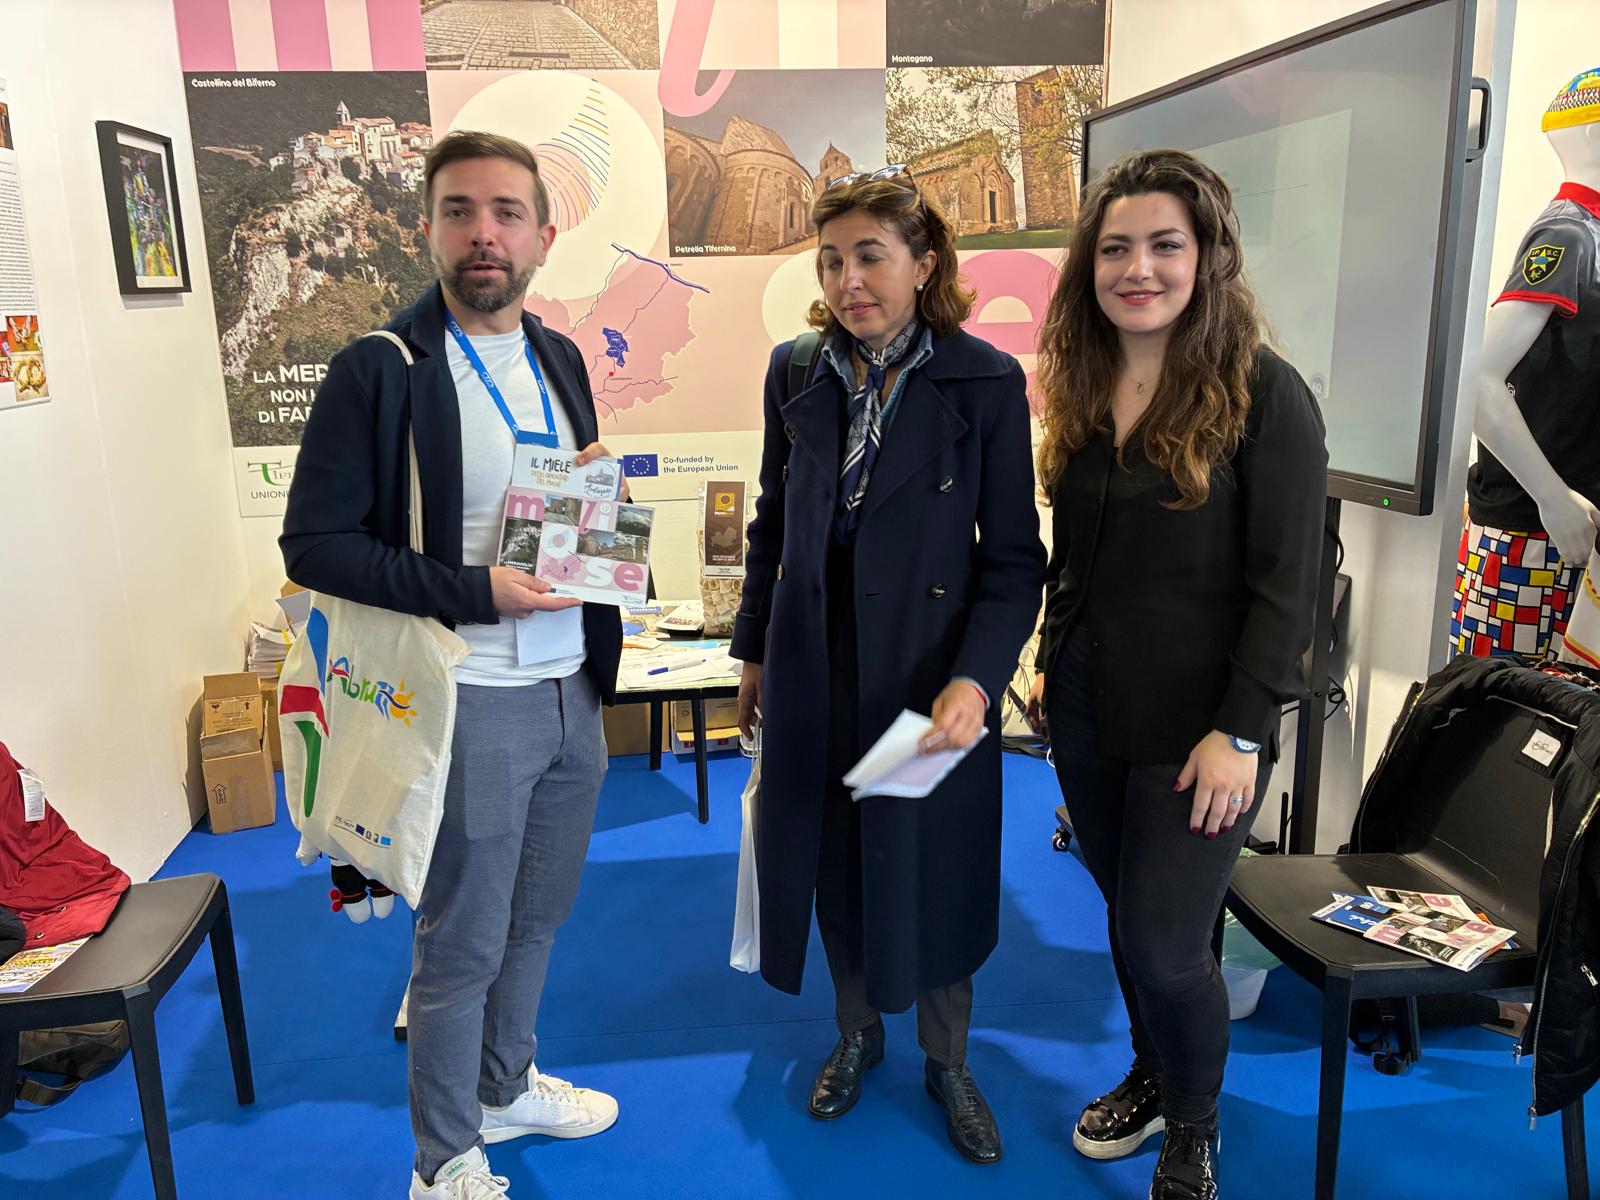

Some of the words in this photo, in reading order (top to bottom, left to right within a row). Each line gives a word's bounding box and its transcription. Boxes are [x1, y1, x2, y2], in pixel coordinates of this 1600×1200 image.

[891, 55, 934, 65] Montagano
[191, 78, 232, 87] Castellino
[232, 78, 245, 87] del
[246, 77, 276, 88] Biferno
[674, 245, 704, 253] Petrella
[704, 244, 737, 253] Tifernina
[252, 370, 278, 384] LA
[269, 389, 308, 403] NON
[258, 410, 276, 424] DI
[662, 456, 703, 465] Co-funded
[703, 455, 714, 464] by
[530, 457, 540, 469] IL
[543, 458, 572, 474] MIELE
[663, 465, 676, 473] the
[677, 464, 714, 474] European
[716, 464, 739, 472] Union
[250, 490, 290, 499] UNION
